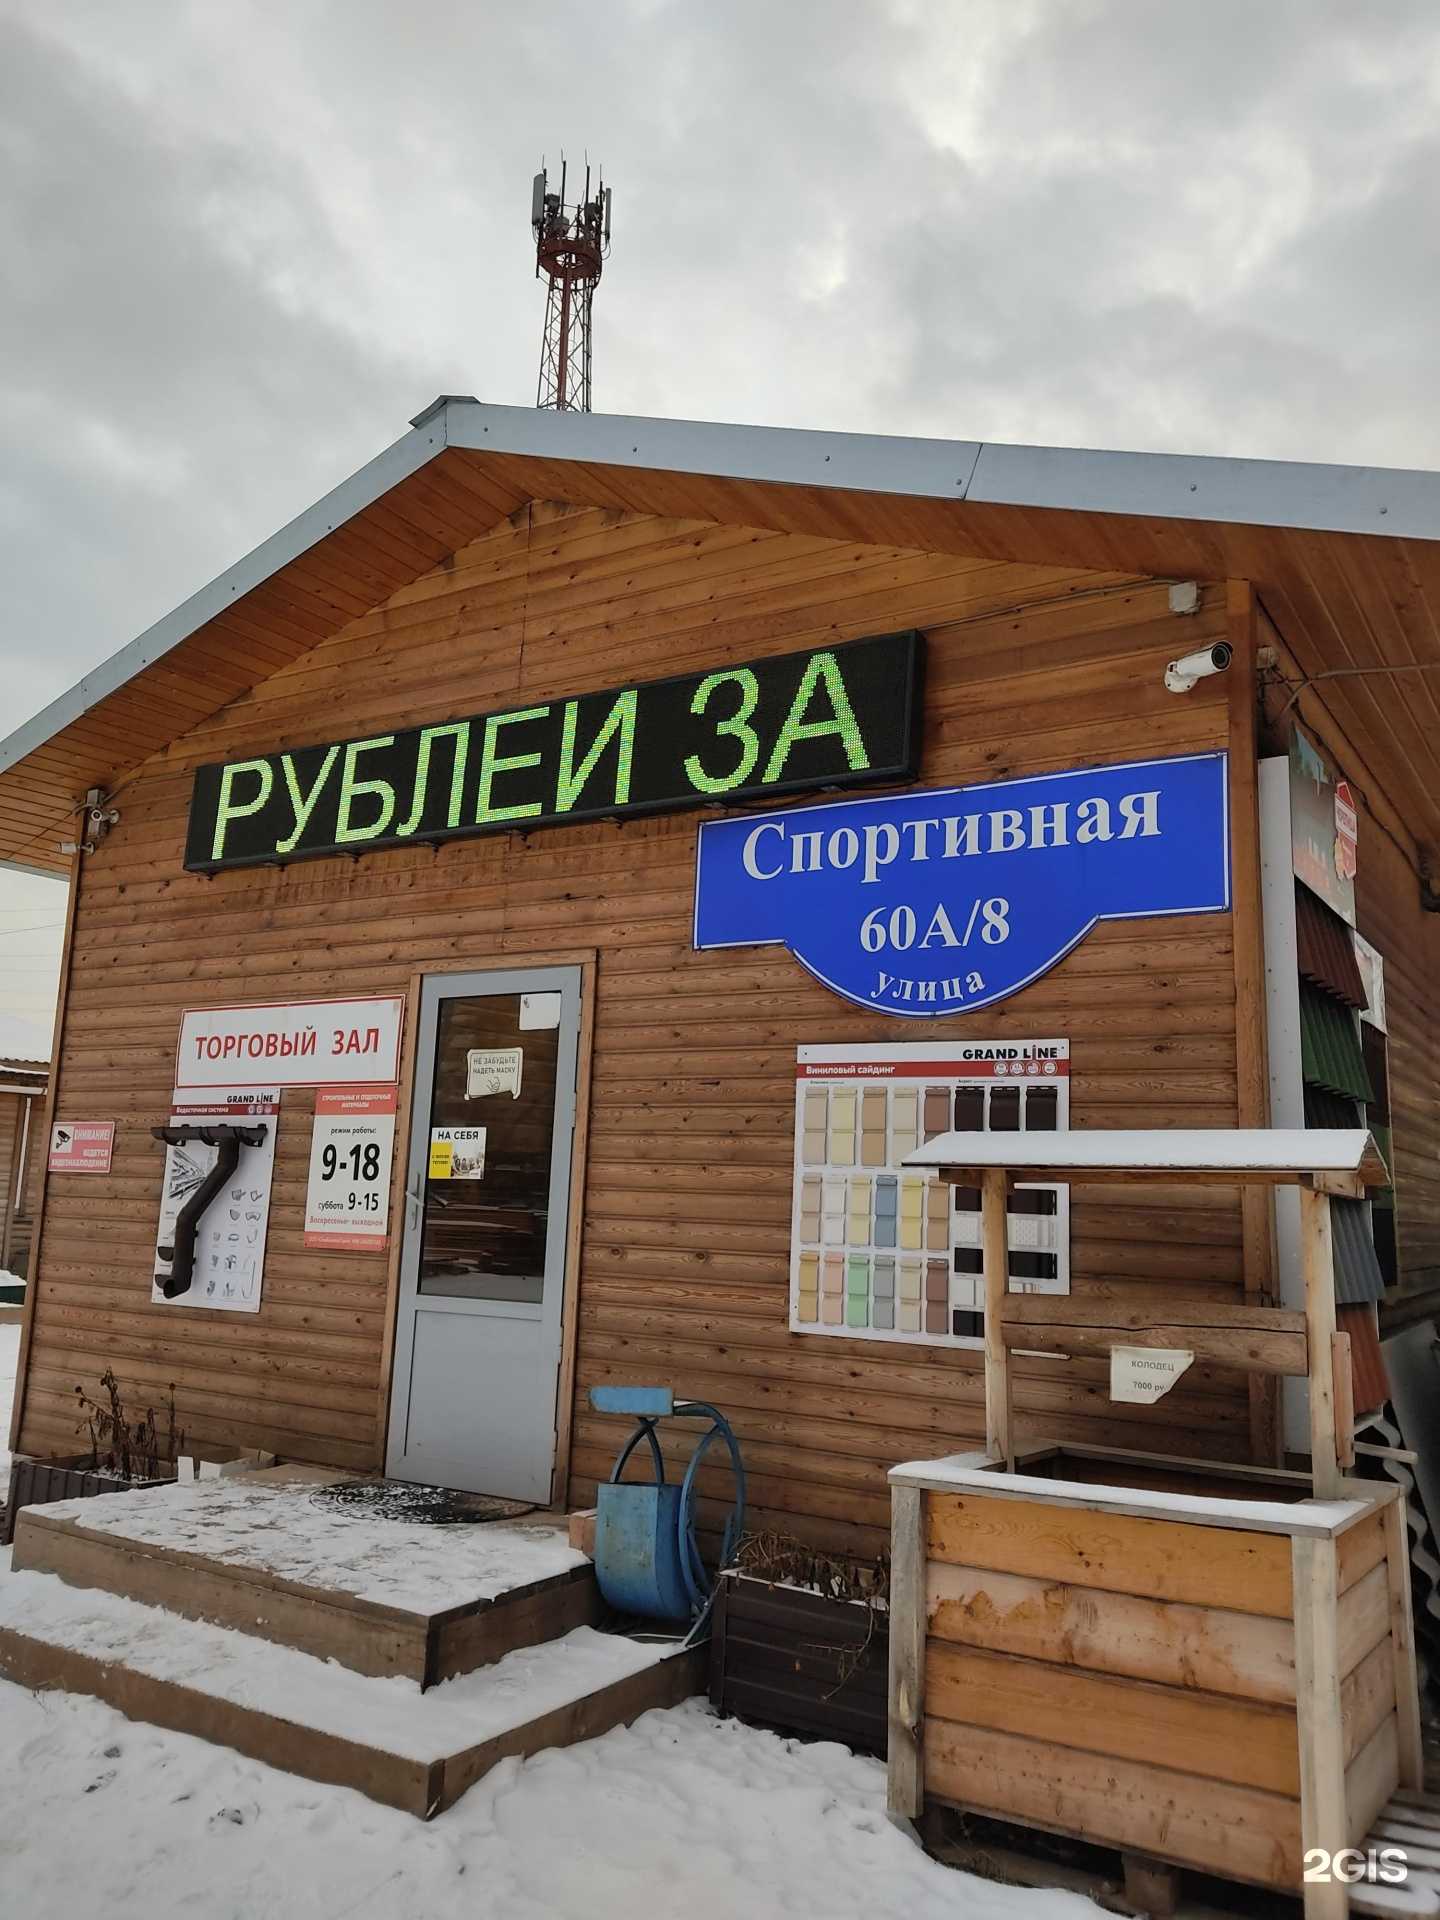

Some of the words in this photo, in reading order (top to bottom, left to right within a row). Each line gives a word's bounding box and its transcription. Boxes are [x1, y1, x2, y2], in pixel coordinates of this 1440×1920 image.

[684, 651, 871, 795] ЗА
[742, 790, 1163, 885] Спортивная
[859, 897, 1011, 954] 60А/8
[870, 970, 986, 1003] улица
[195, 1025, 317, 1060] ТОРГОВЫЙ
[331, 1028, 380, 1056] ЗАЛ
[962, 1048, 1018, 1060] GRAND
[805, 1065, 857, 1075] Виниловый
[857, 1065, 896, 1076] сайдинг
[226, 1095, 254, 1104] GRAND
[330, 1128, 351, 1136] режим
[352, 1126, 377, 1136] работы:
[437, 1131, 451, 1140] НА
[453, 1130, 479, 1140] СЕБЯ
[321, 1143, 380, 1181] 9-18
[317, 1200, 344, 1212] суббота
[1131, 1360, 1175, 1372] КОЛОДЕЦ
[1133, 1381, 1153, 1391] 7000
